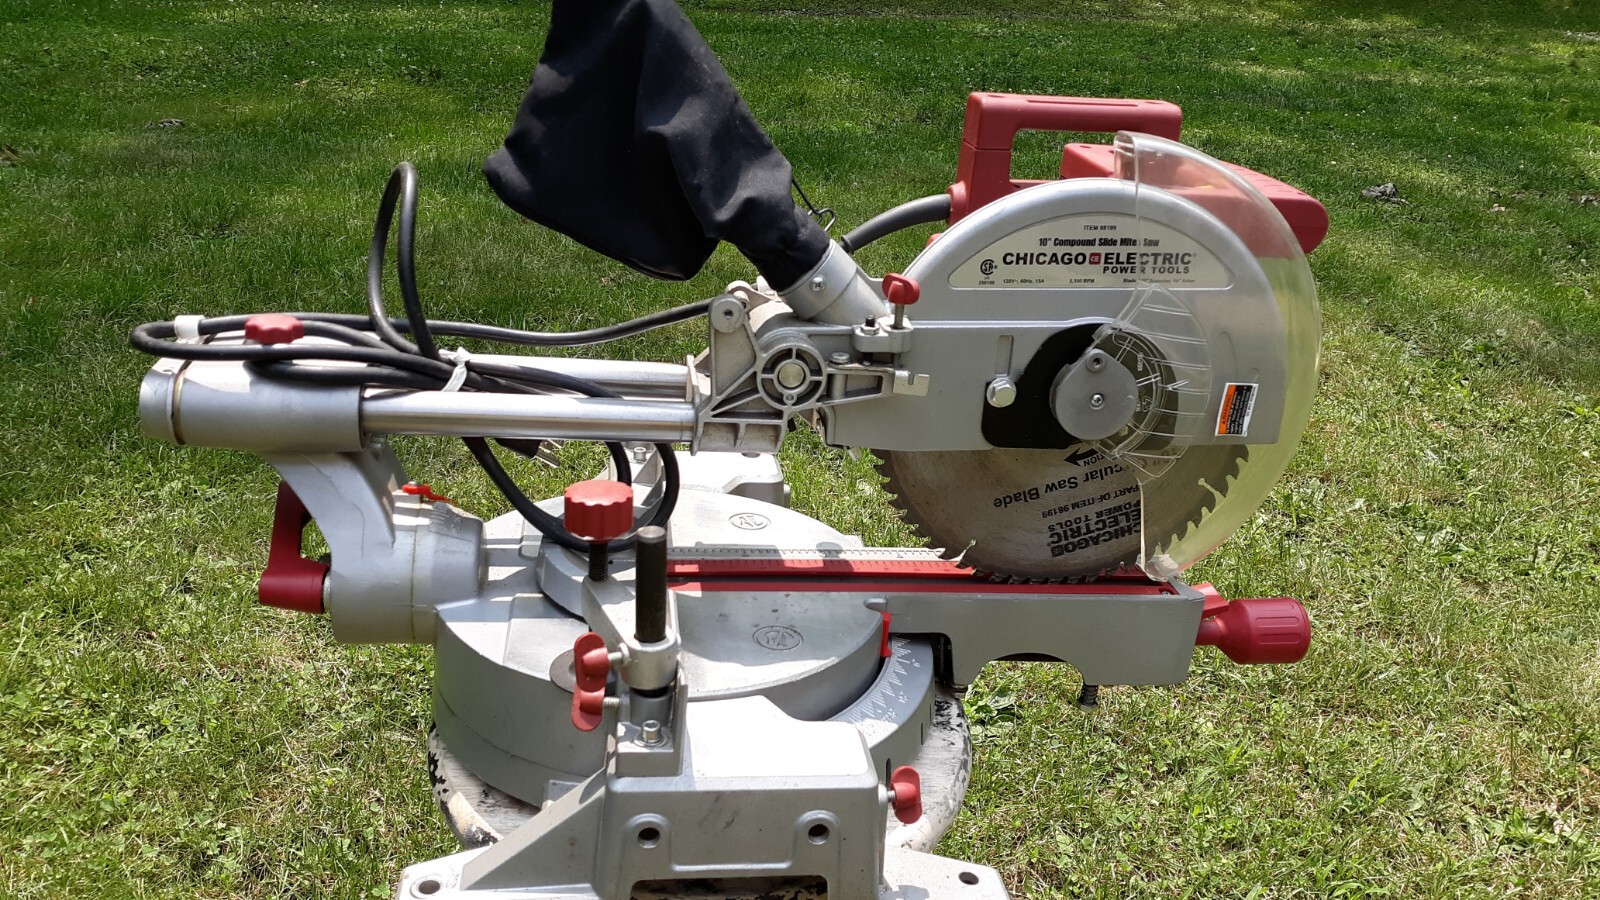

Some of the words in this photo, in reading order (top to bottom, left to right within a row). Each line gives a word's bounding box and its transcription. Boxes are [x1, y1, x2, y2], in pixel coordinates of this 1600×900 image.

[1039, 237, 1052, 247] 10"
[1053, 237, 1096, 248] Compound
[1098, 237, 1118, 247] Slide
[1143, 238, 1160, 247] Saw
[1002, 252, 1087, 265] CHICAGO
[1103, 252, 1192, 265] ELECTRIC
[1102, 266, 1146, 274] POWER
[1152, 266, 1190, 274] TOOLS
[1083, 463, 1126, 484] cular
[1044, 475, 1079, 494] Saw
[1112, 484, 1140, 498] PART
[993, 487, 1040, 509] Blade
[1071, 497, 1095, 511] ITEM
[1099, 492, 1111, 502] OF
[1042, 505, 1070, 519] 98199
[1095, 499, 1141, 518] POWER
[1047, 514, 1091, 532] TOOLS
[1049, 507, 1141, 545] ELECTRIC
[1062, 522, 1141, 552] CHICAGO
